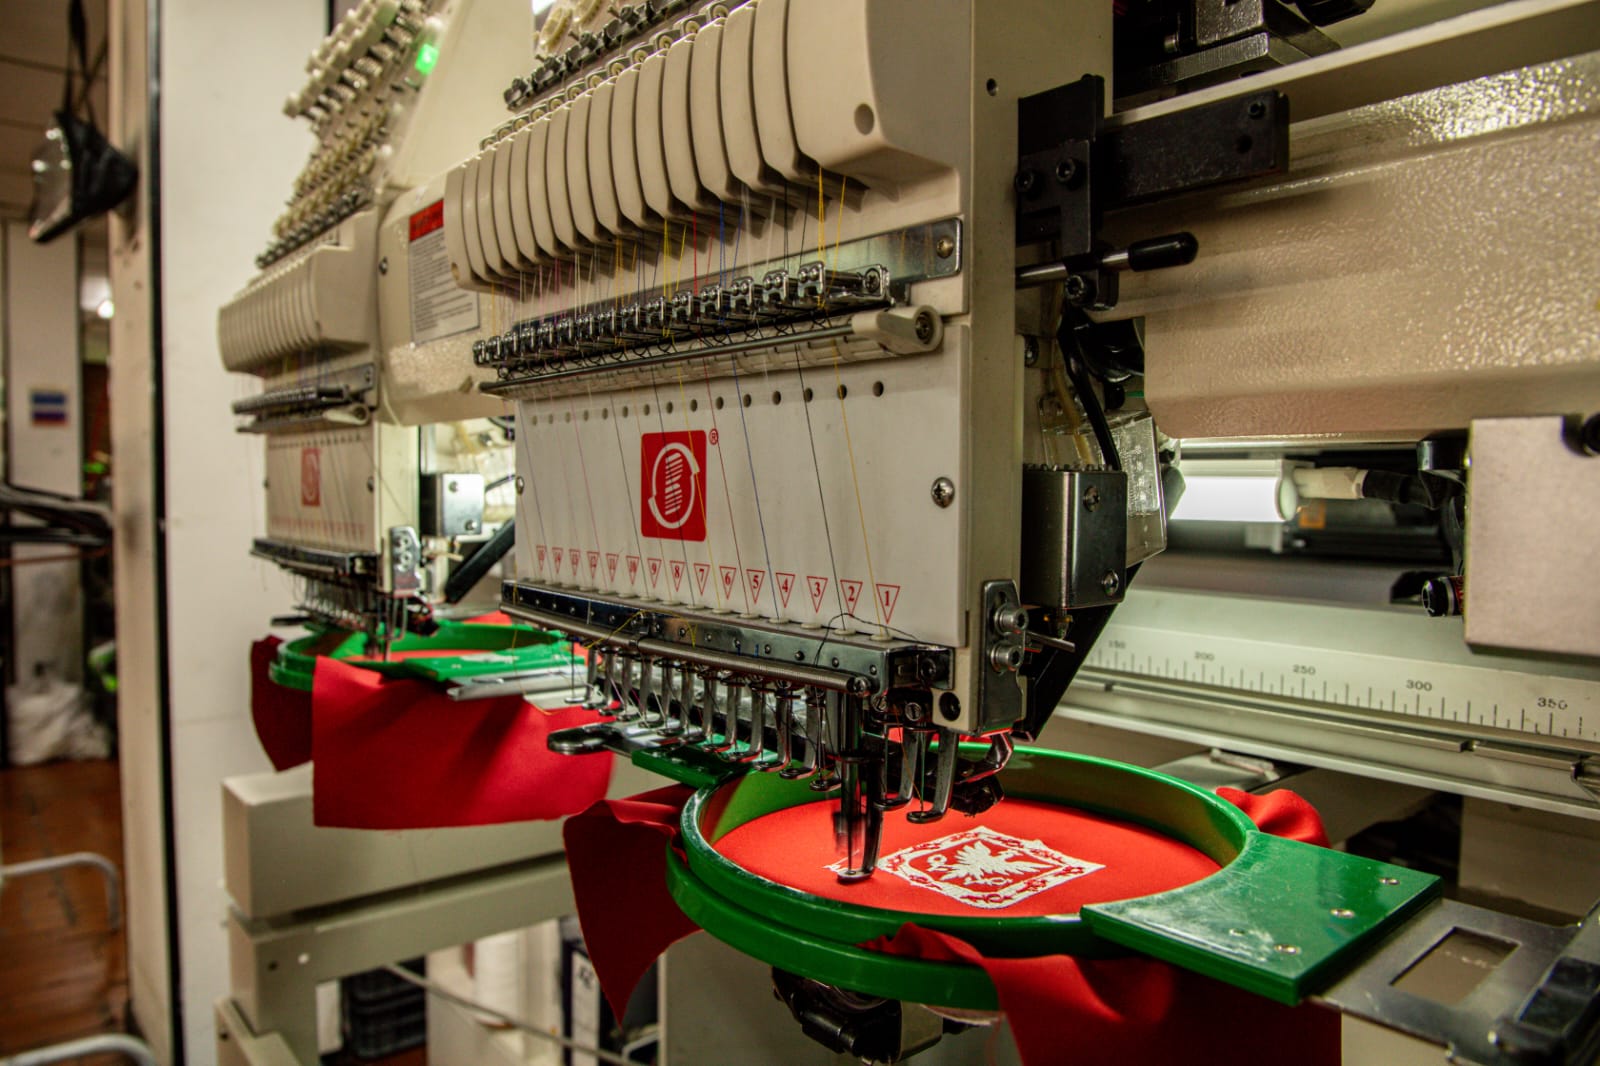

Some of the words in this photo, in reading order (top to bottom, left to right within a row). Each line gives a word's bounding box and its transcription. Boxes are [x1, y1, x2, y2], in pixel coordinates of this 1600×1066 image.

[651, 562, 657, 575] 9
[674, 565, 680, 579] 8
[698, 568, 705, 582] 7
[724, 572, 731, 586] 6
[752, 574, 759, 589] 5
[781, 578, 789, 593] 4
[813, 581, 821, 597] 3
[847, 585, 855, 602] 2
[884, 590, 890, 606] 1
[1292, 664, 1316, 675] 250
[1406, 679, 1433, 692] 300
[1537, 697, 1568, 710] 350
